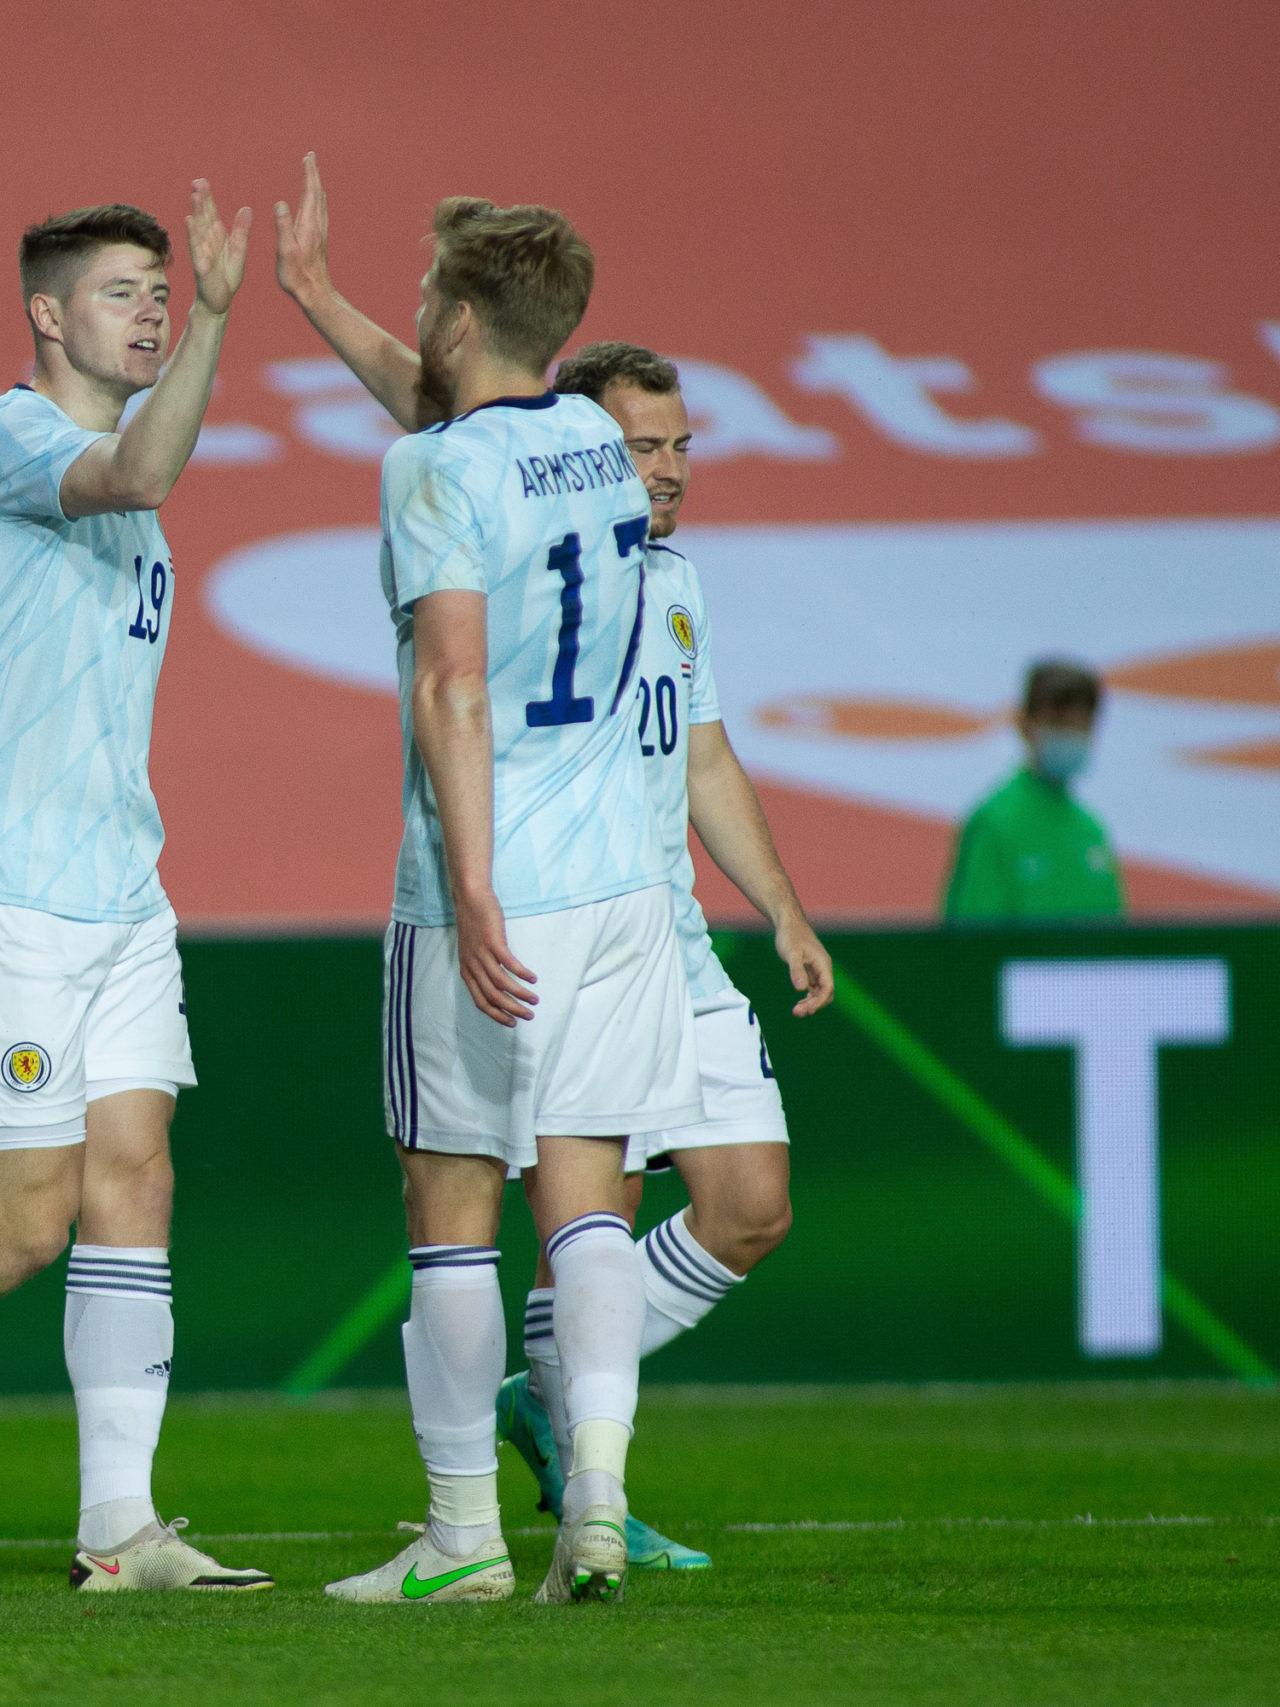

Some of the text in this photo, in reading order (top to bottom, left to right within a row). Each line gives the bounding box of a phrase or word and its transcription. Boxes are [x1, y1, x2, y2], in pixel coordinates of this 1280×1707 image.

[516, 438, 639, 498] ARMSTRON
[129, 555, 166, 644] 19
[525, 516, 649, 728] 17
[636, 675, 677, 756] 20
[1000, 957, 1232, 1357] T
